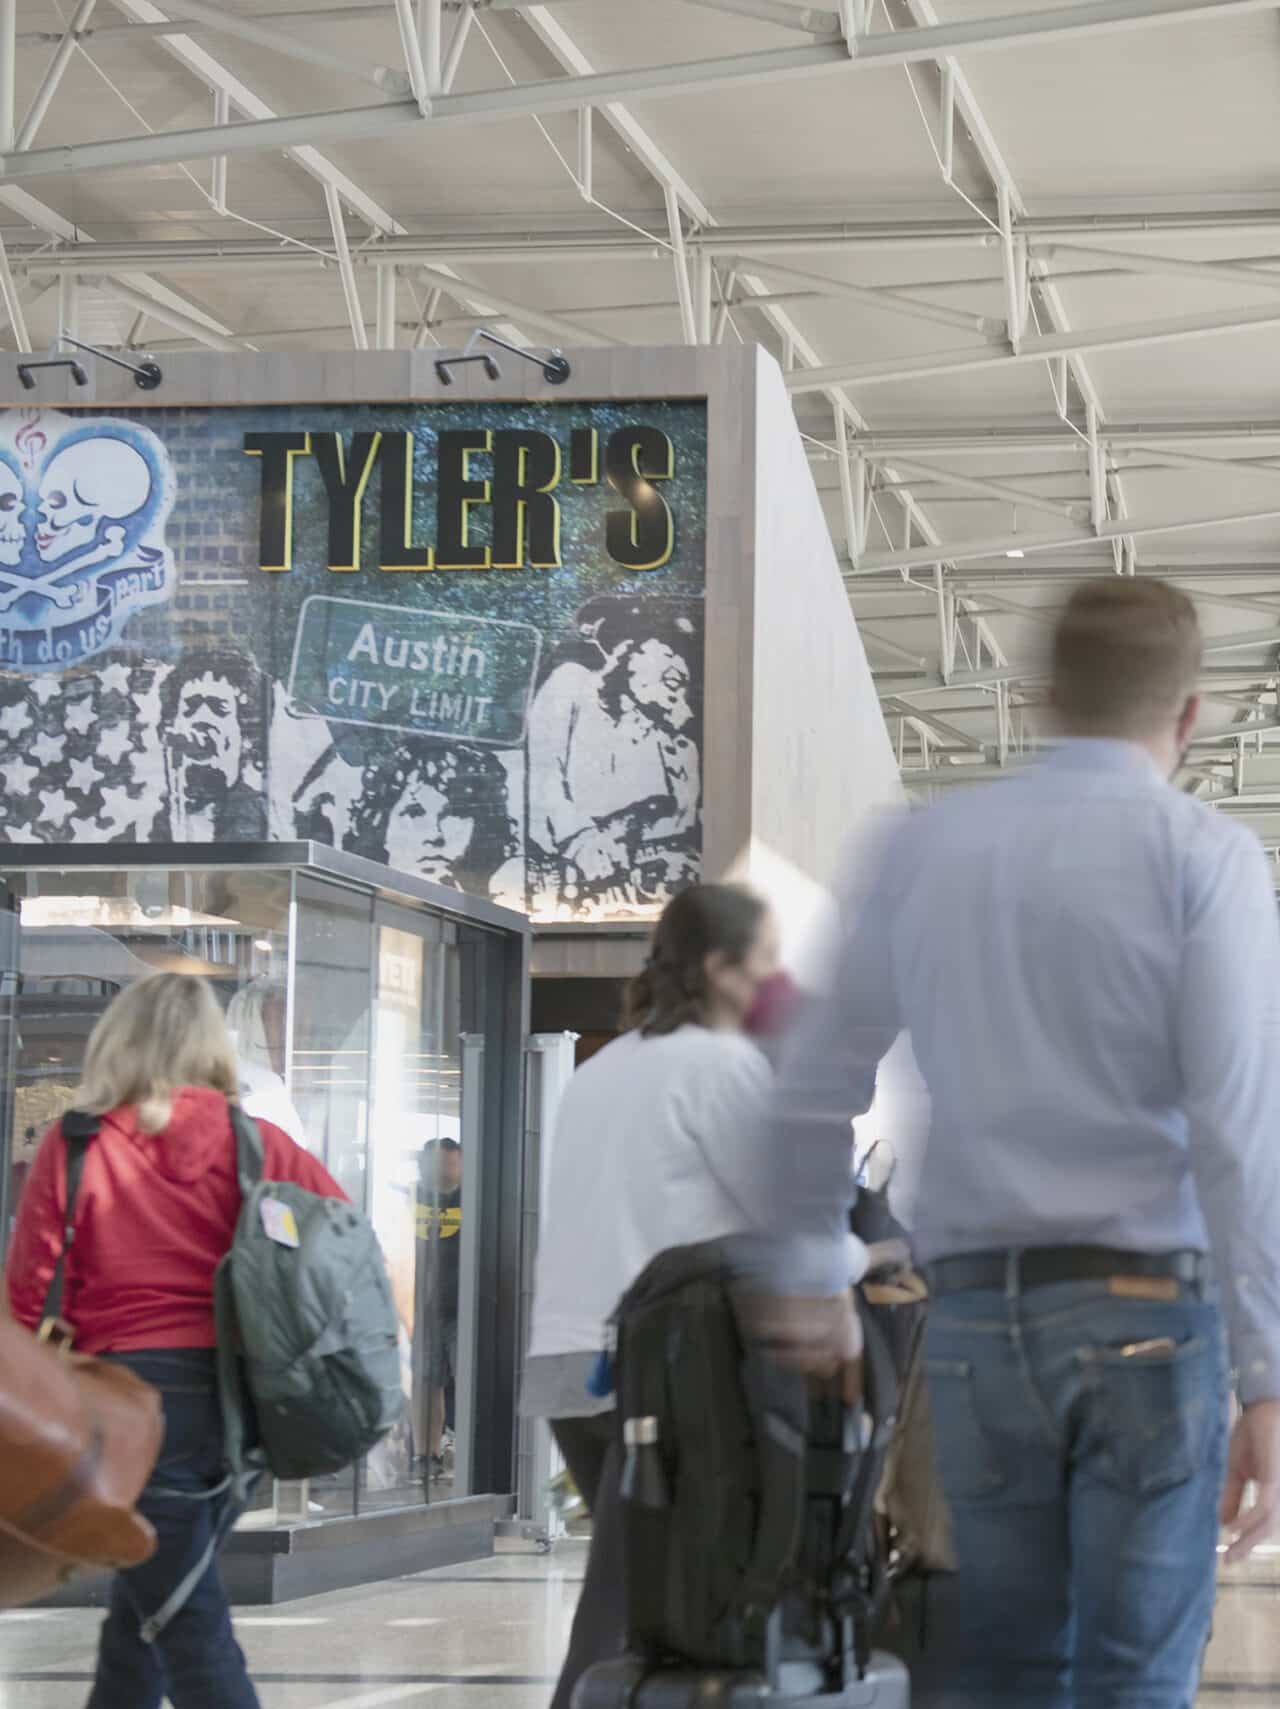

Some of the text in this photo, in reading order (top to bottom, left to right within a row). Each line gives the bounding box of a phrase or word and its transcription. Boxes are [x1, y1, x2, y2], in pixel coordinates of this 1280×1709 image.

[243, 424, 675, 572] TYLER'S
[347, 622, 486, 679] Austin
[328, 677, 398, 712] CITY
